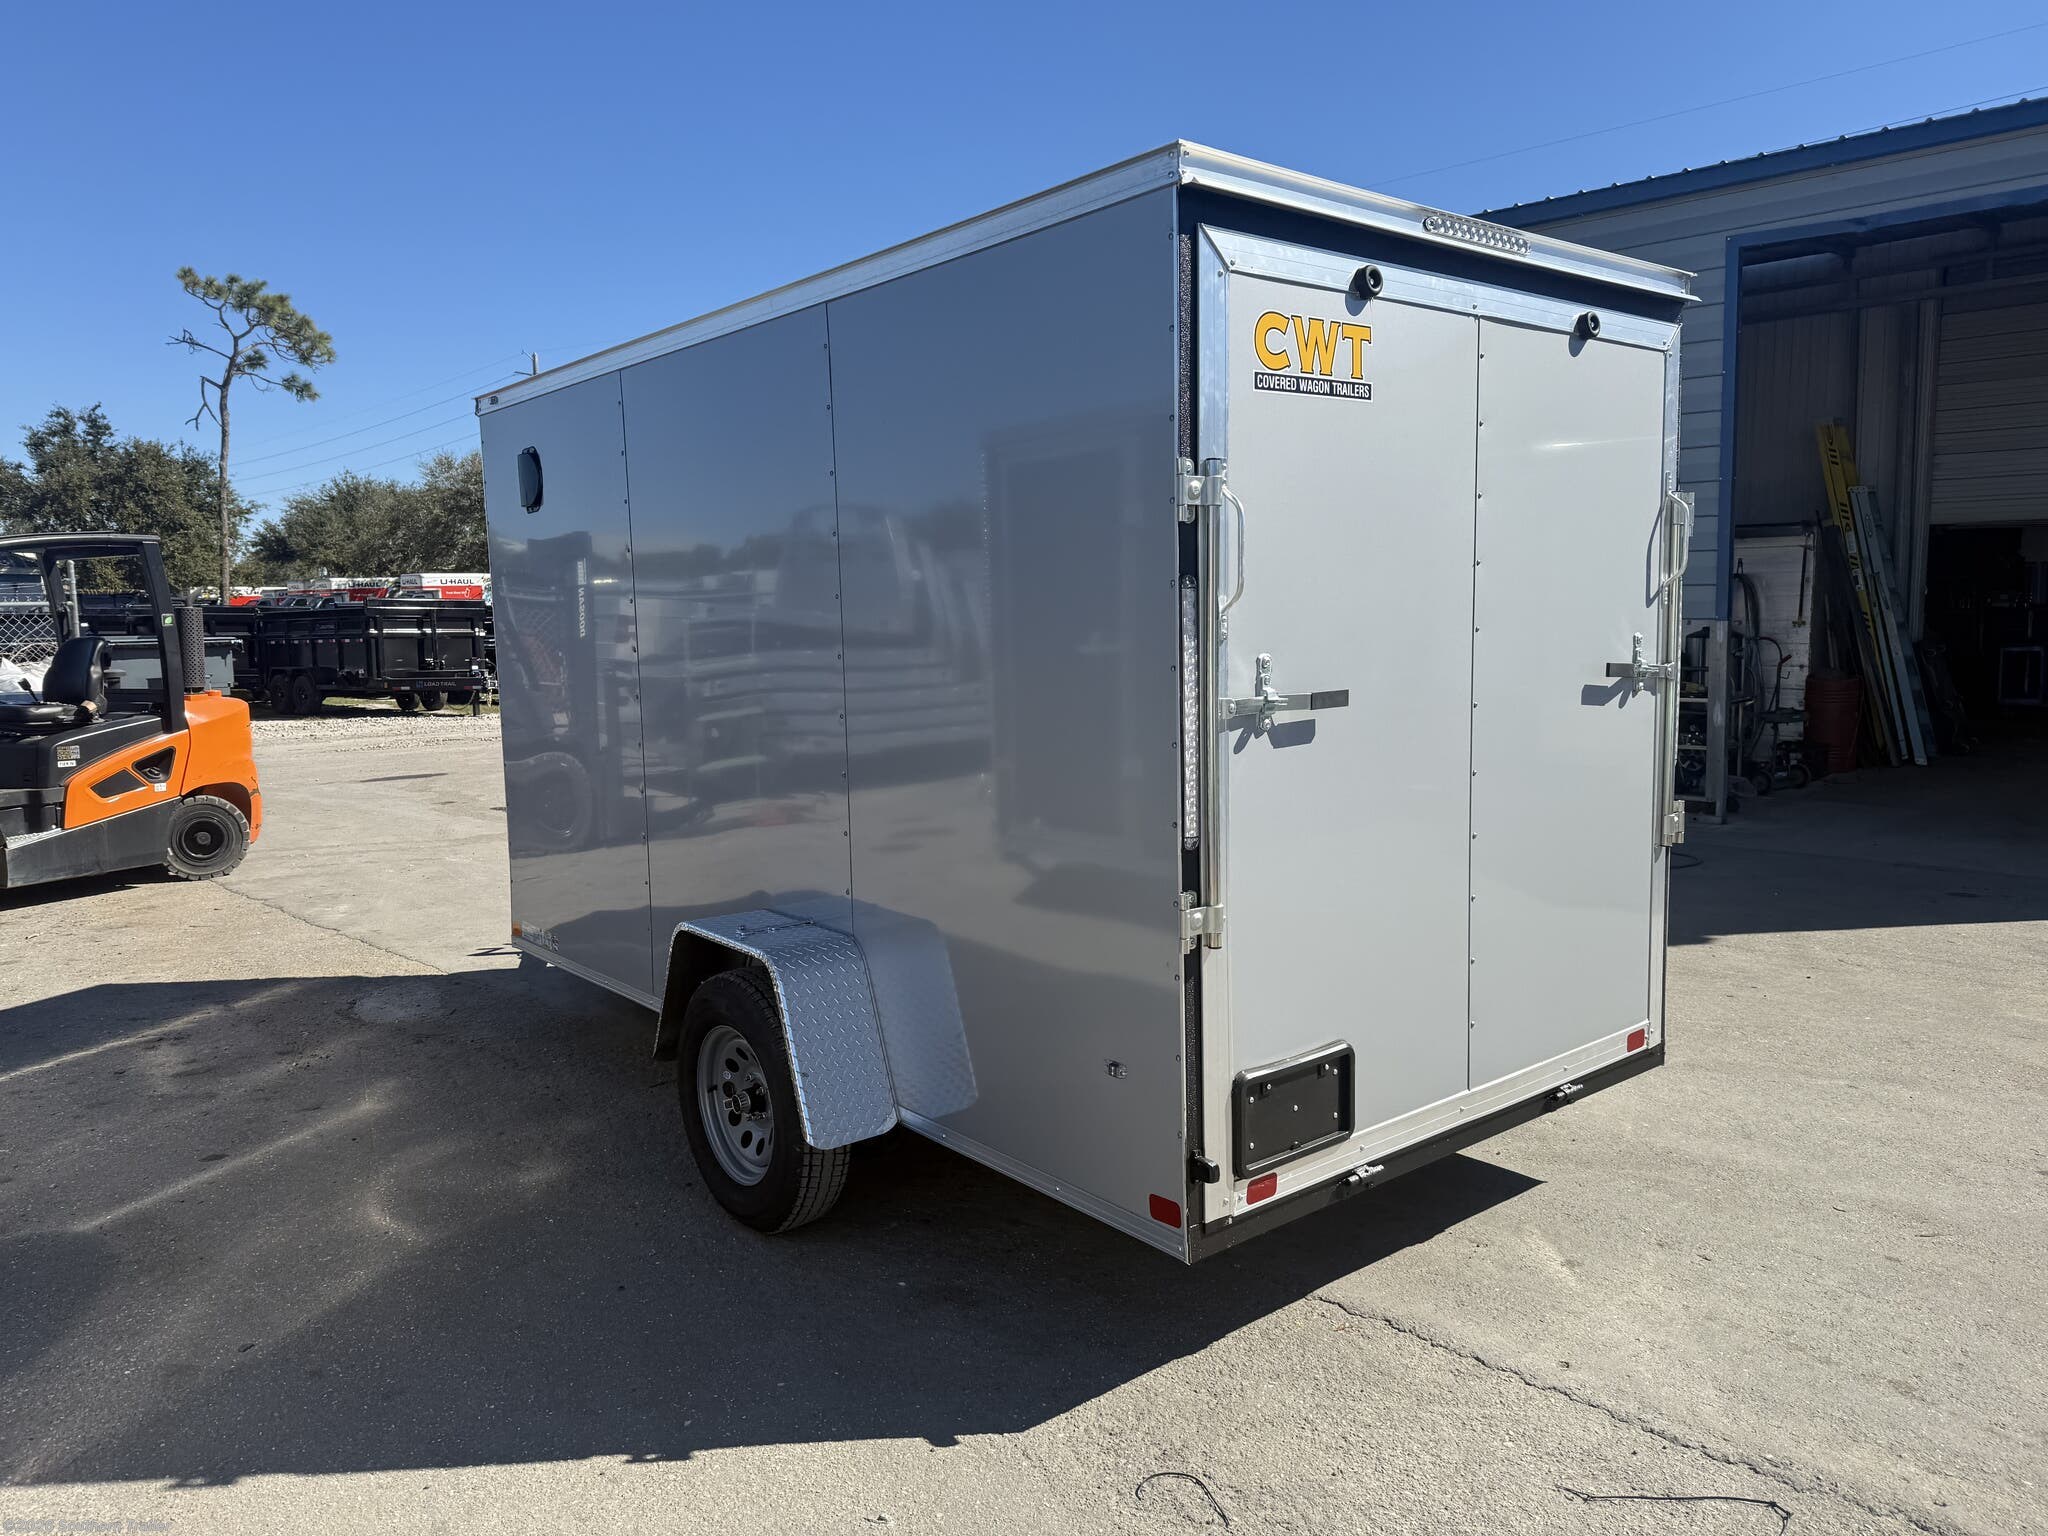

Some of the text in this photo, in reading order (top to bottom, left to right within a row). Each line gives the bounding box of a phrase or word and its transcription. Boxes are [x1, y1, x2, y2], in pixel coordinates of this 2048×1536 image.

[1254, 310, 1372, 380] CWT
[1256, 374, 1370, 398] COVERED WAGON TRAILERS
